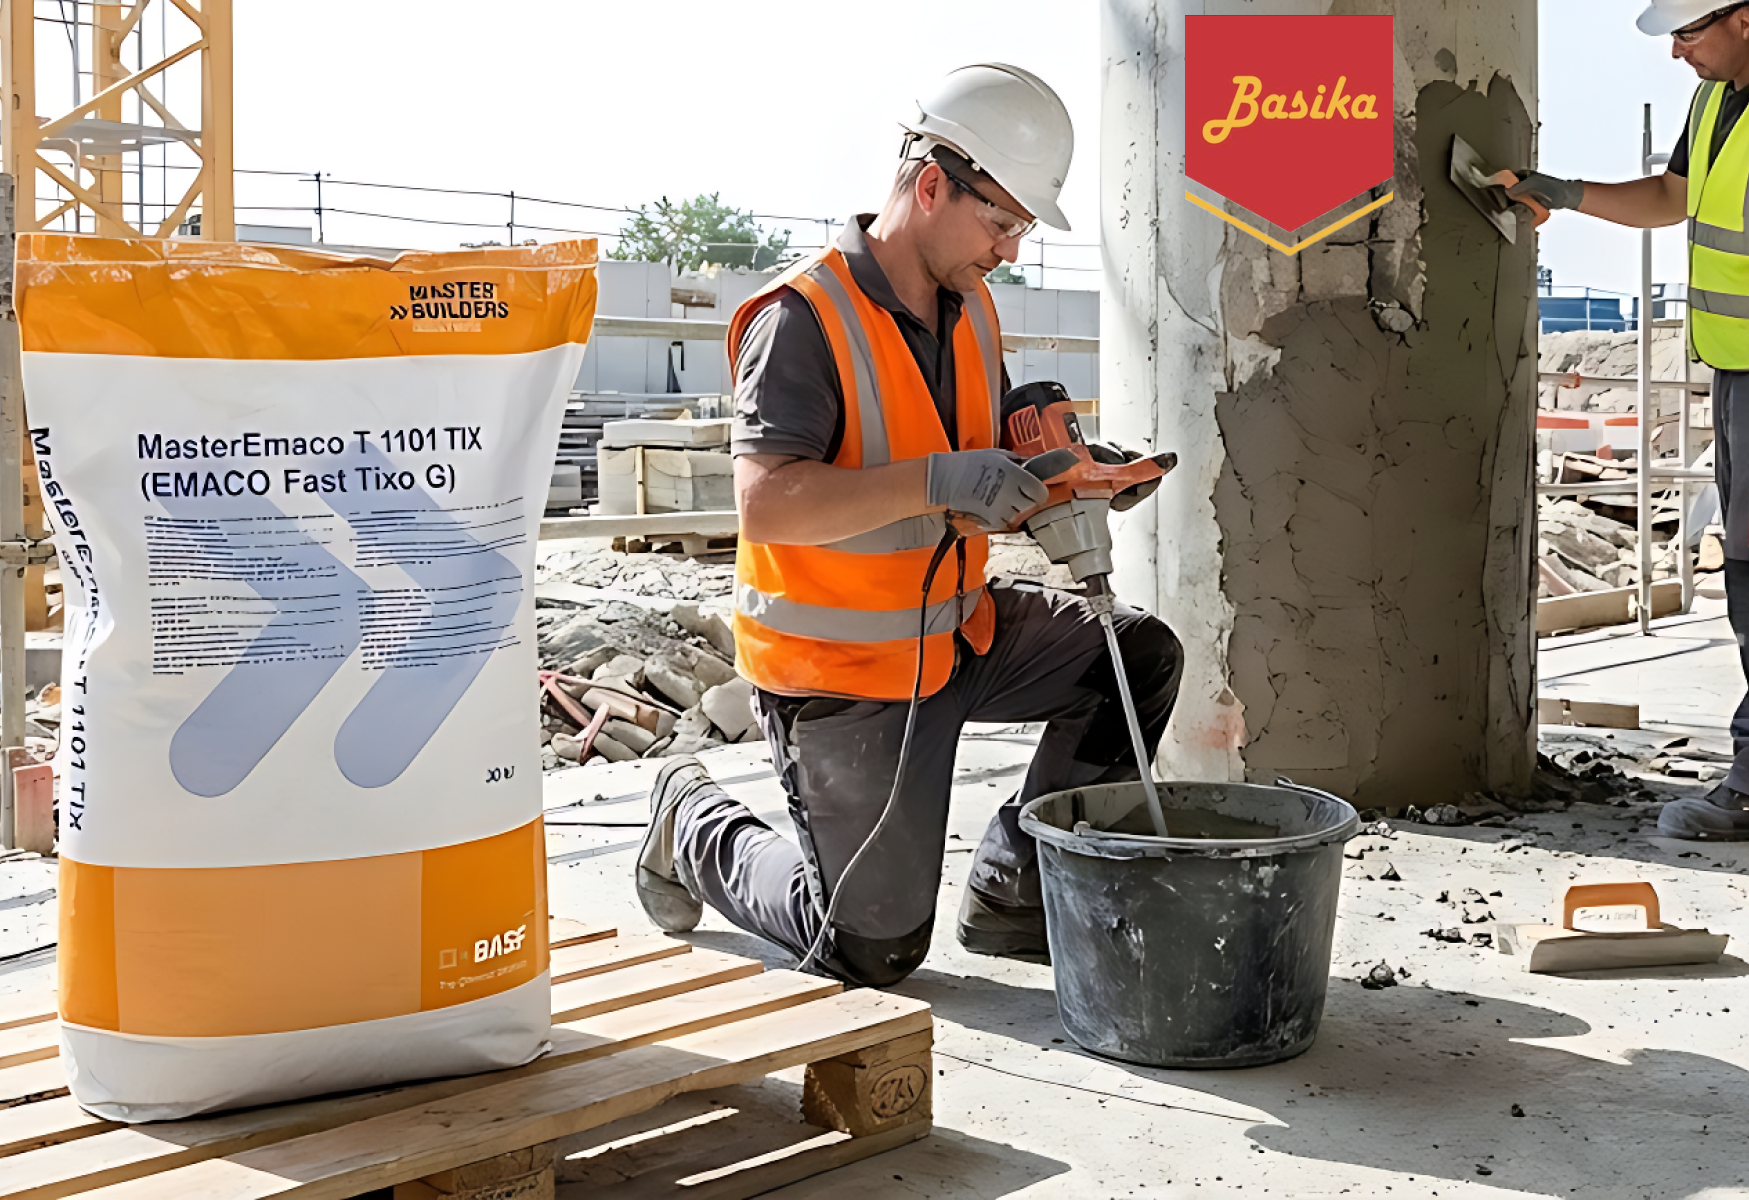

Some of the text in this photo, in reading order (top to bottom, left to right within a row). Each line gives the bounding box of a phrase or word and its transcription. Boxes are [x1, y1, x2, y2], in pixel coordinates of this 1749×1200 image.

[412, 300, 508, 319] BUILDERS
[138, 426, 482, 459] MasterEmaco T 1101 TIX
[141, 464, 455, 501] (EMACO Fast Tixo G)
[73, 676, 88, 695] T
[70, 704, 86, 770] 1101
[69, 782, 86, 831] TIX
